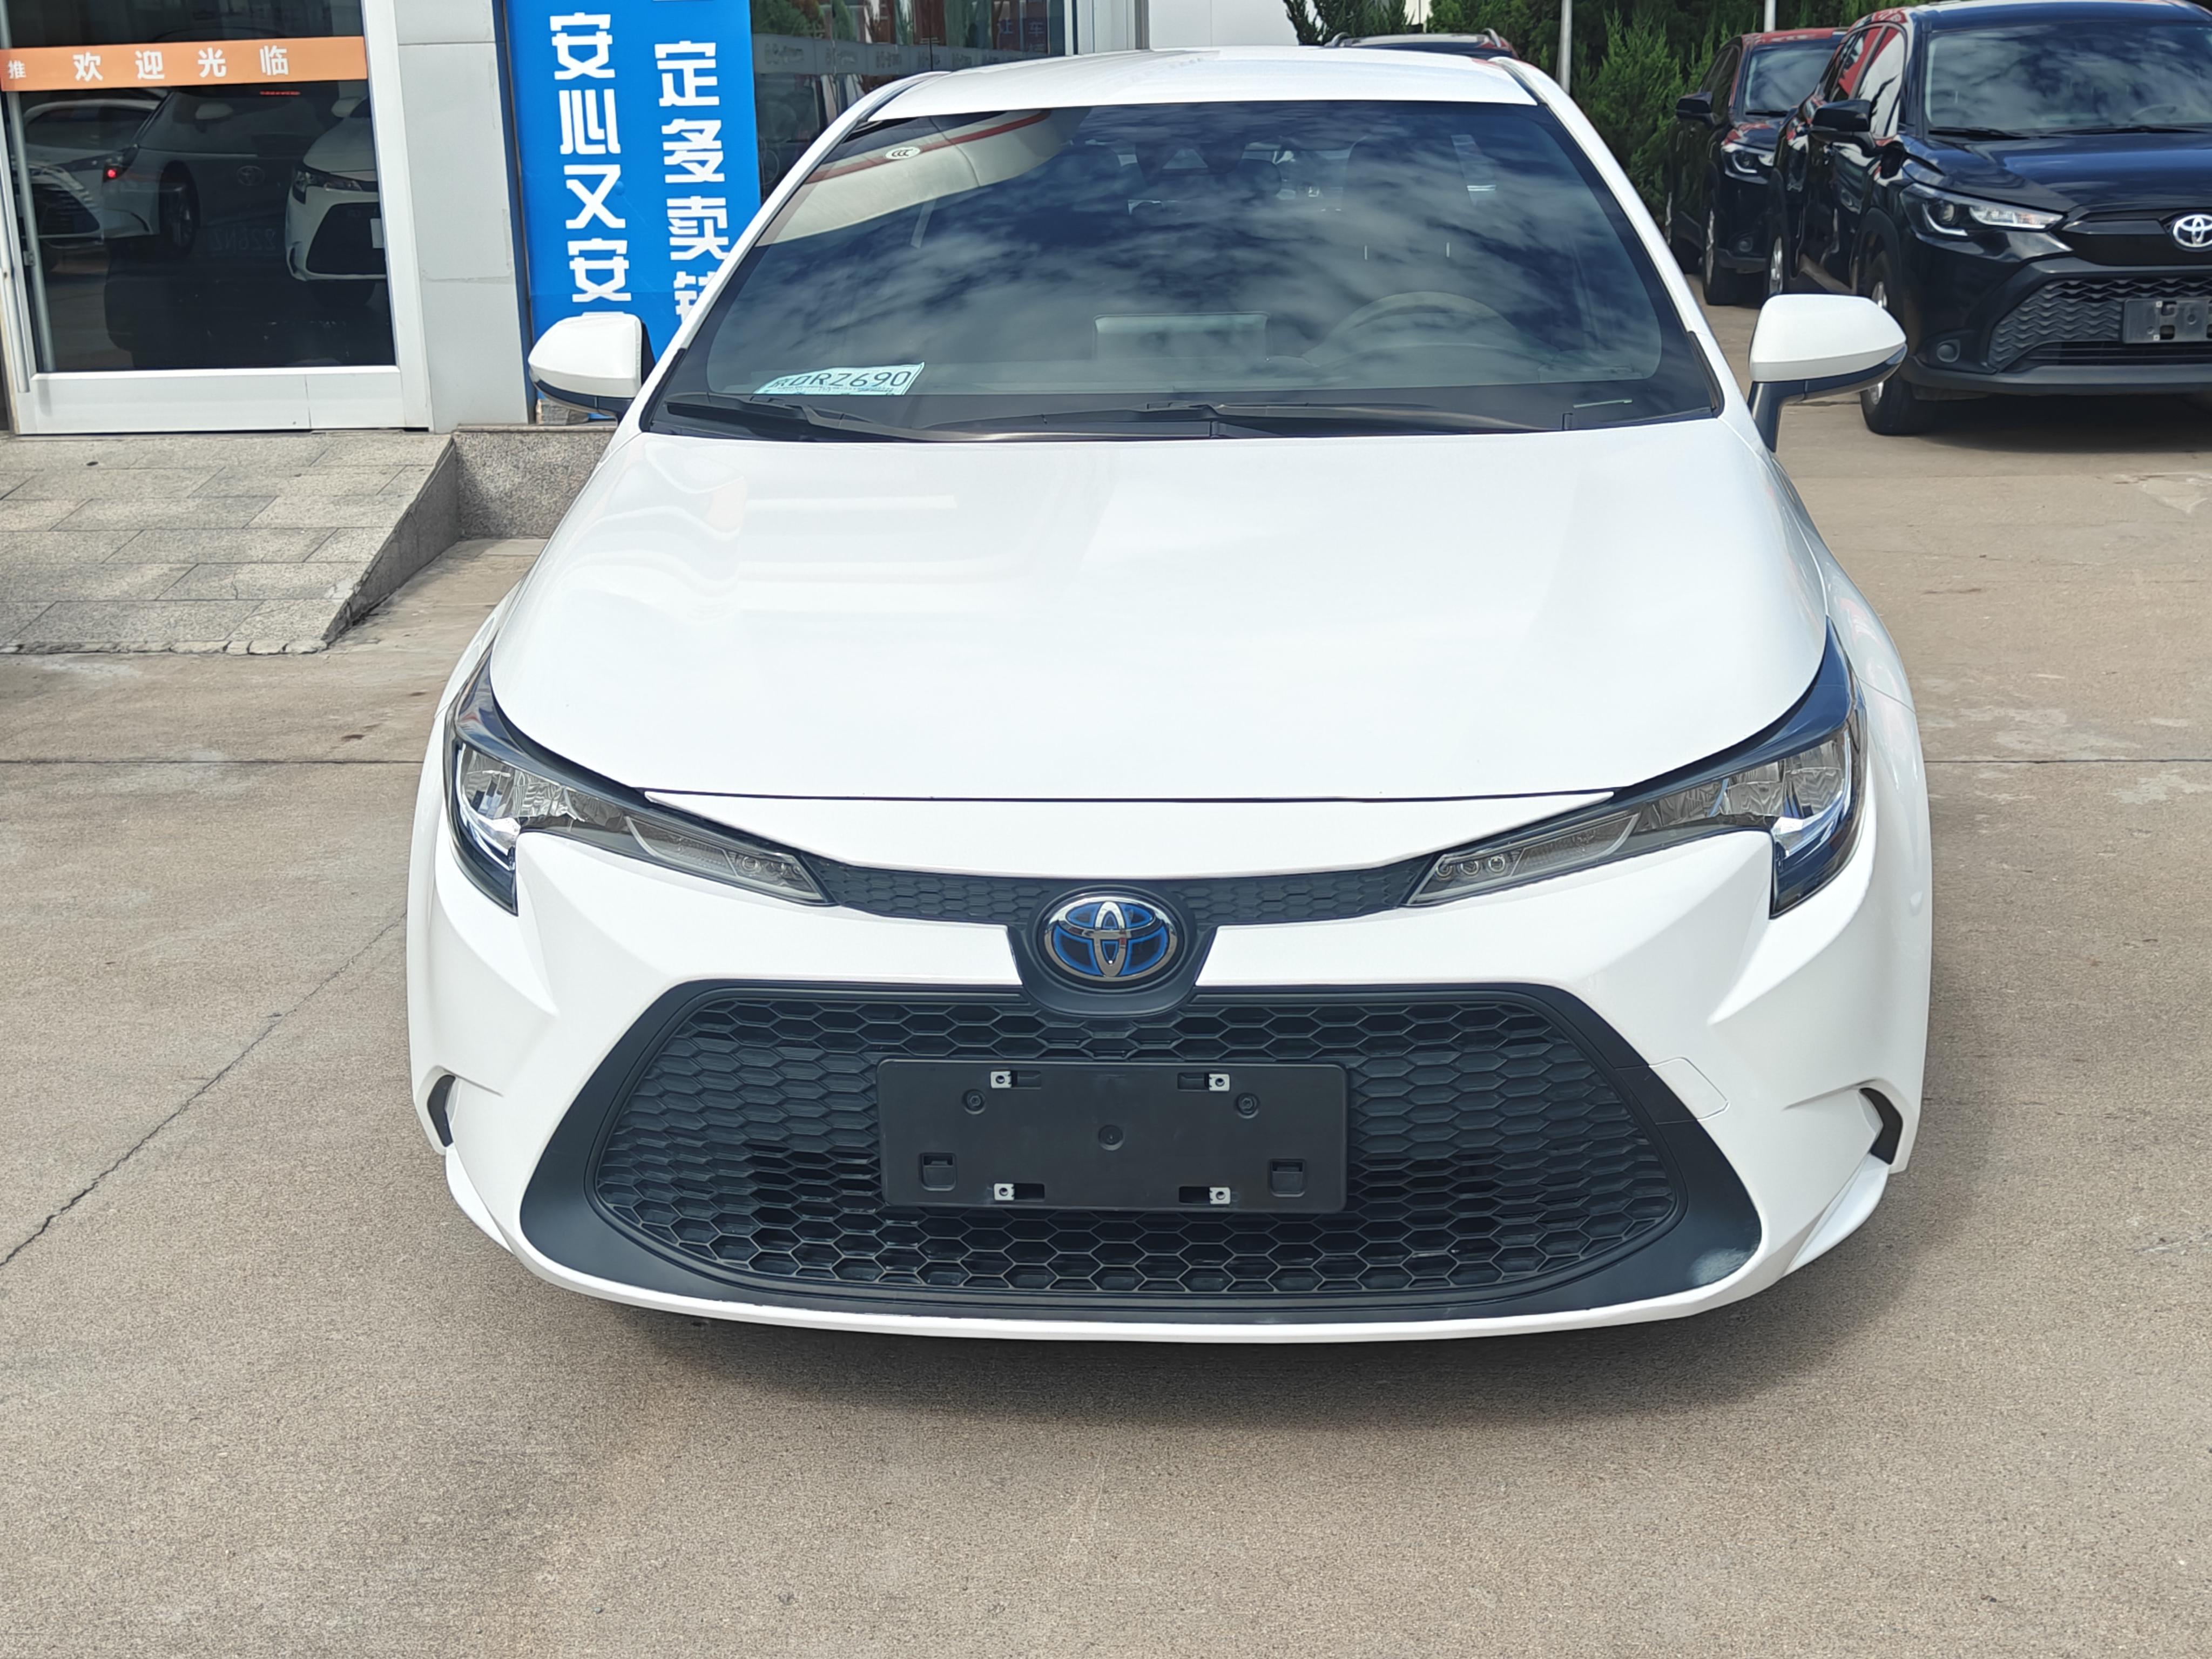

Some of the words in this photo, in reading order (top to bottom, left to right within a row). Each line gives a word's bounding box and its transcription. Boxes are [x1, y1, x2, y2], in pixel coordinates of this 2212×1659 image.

[8, 59, 26, 79] 推
[73, 45, 289, 82] 欢迎光临
[549, 12, 632, 318] 安心又安
